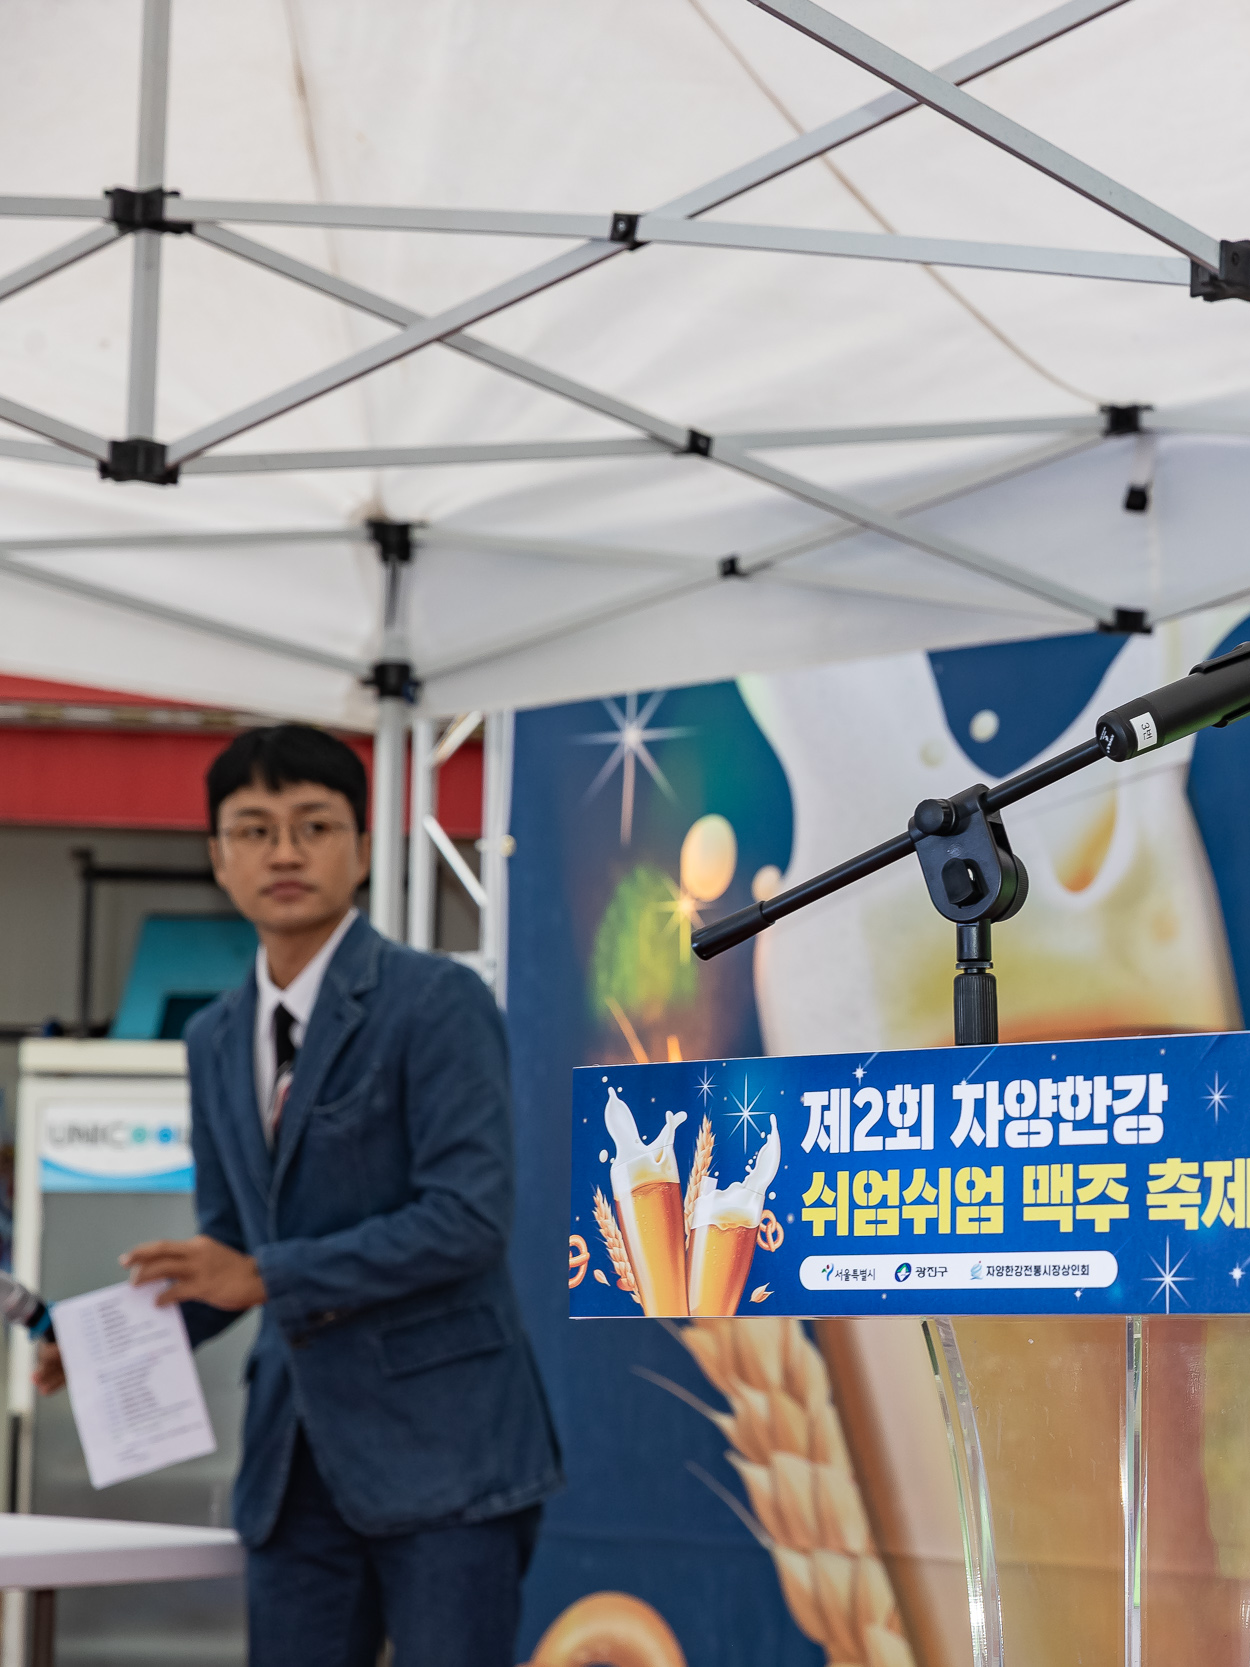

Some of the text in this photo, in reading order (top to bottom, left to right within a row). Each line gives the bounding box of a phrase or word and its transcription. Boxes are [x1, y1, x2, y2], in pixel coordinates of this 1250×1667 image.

[800, 1073, 1169, 1153] 제2회 자양한강
[801, 1165, 1004, 1237] 쉬엄쉬엄
[1022, 1163, 1130, 1233] 맥주
[834, 1269, 876, 1281] 서울특별시
[915, 1266, 948, 1278] 광진구
[986, 1264, 1090, 1277] 자양한강전통시장상인회
